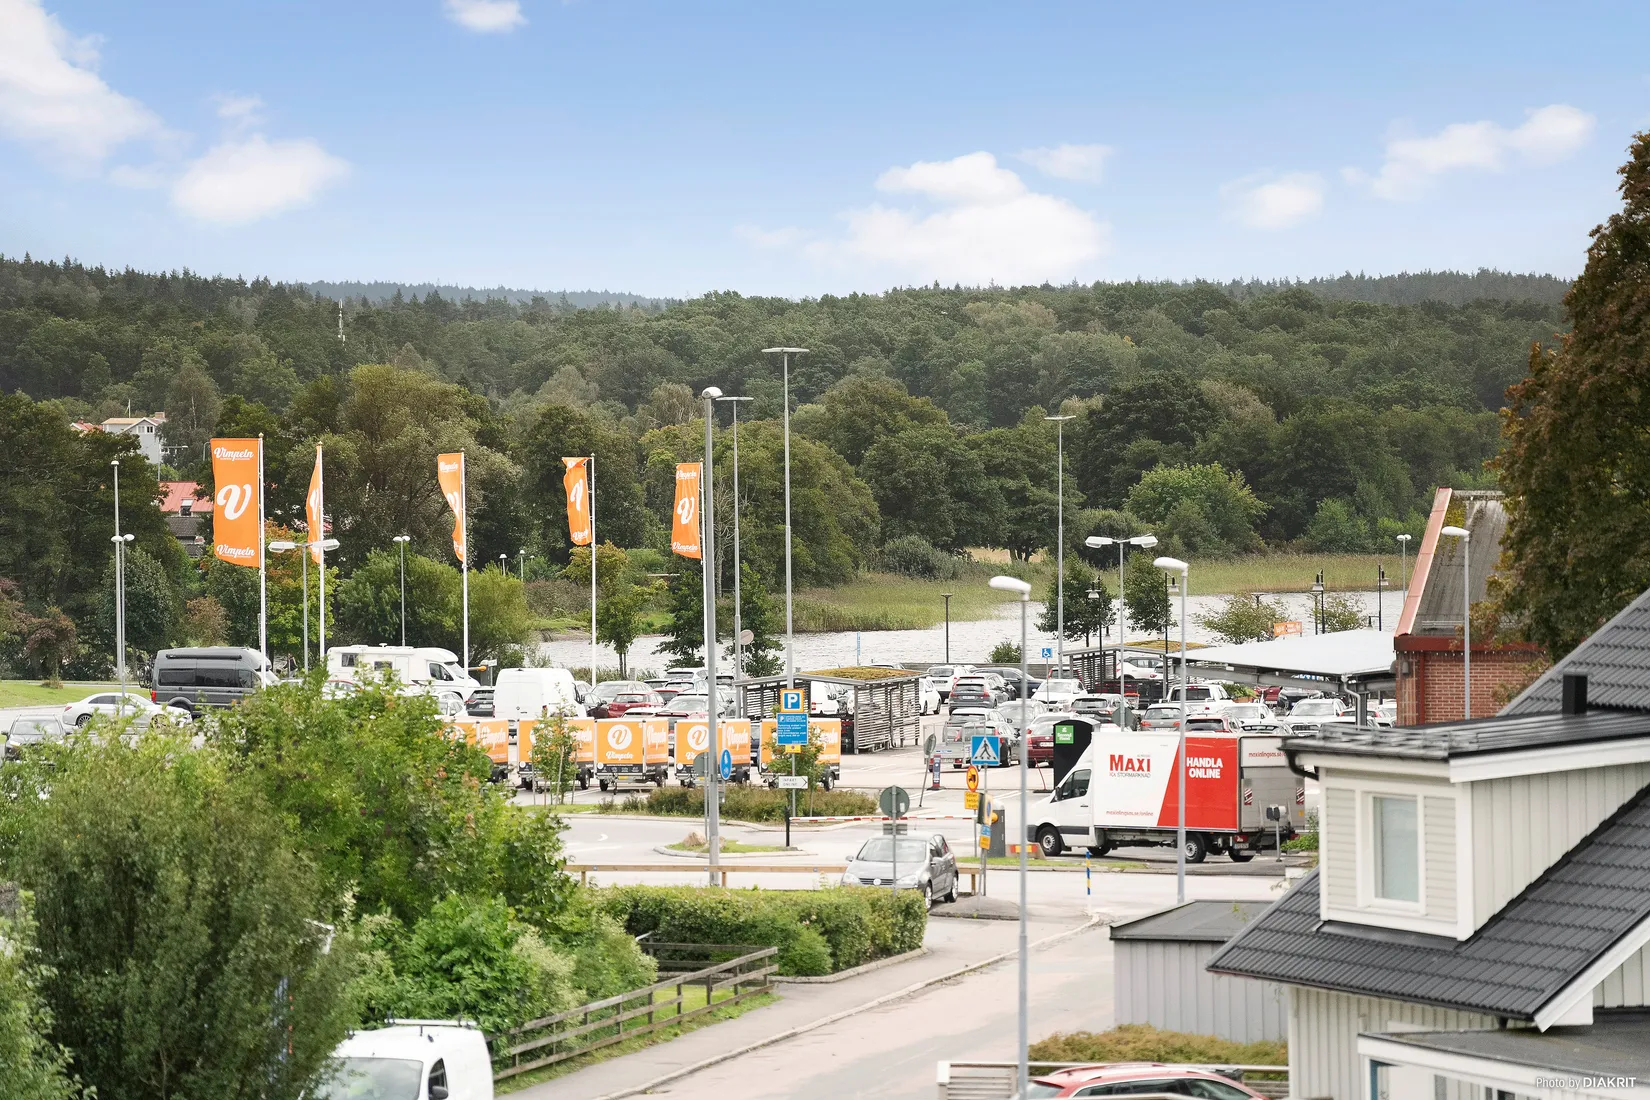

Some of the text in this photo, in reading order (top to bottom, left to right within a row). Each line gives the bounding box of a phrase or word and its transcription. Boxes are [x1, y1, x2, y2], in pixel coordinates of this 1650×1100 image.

[214, 447, 254, 461] Vimpeln
[216, 544, 255, 558] Vimpeln
[787, 693, 798, 709] P
[605, 751, 634, 761] Vimpeln
[1186, 757, 1223, 768] HANDLA
[1188, 768, 1221, 779] ONLINE
